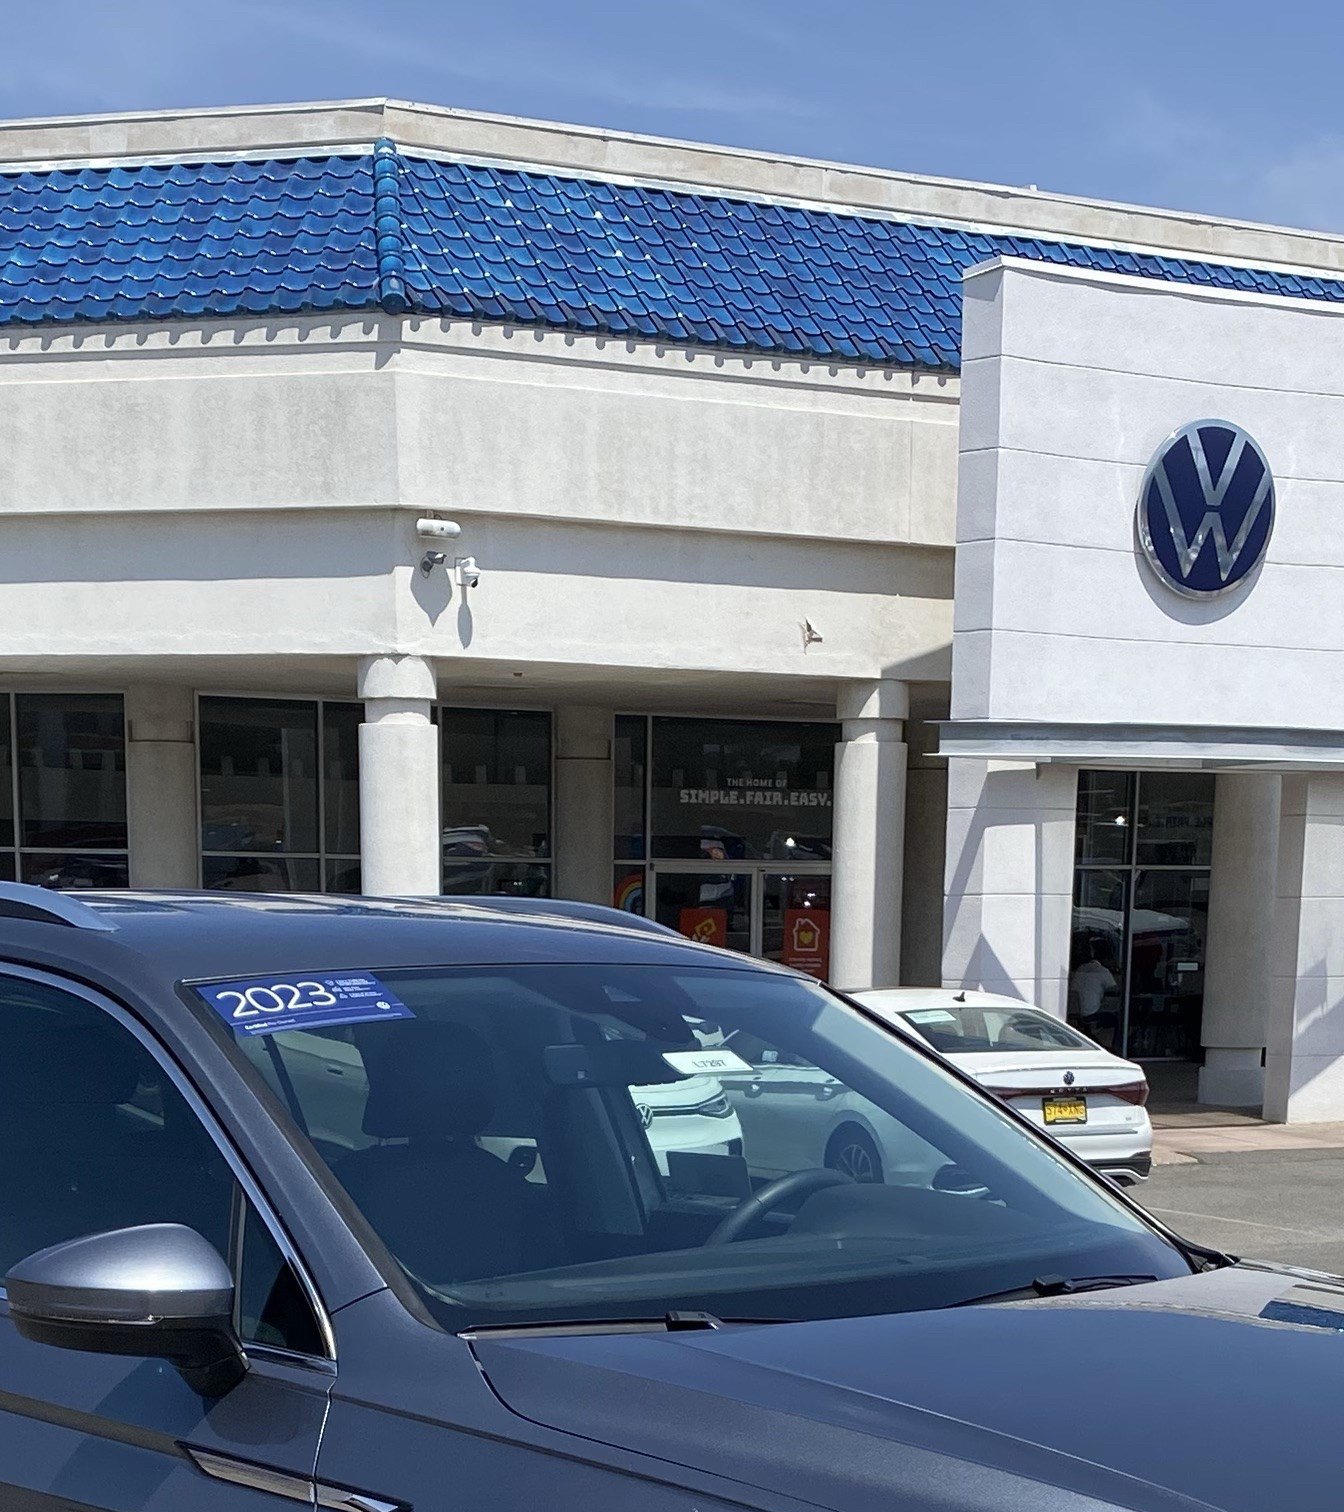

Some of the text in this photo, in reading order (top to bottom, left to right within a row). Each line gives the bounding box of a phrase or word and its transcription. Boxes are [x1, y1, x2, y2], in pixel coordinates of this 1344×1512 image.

[1140, 421, 1275, 598] VW
[726, 778, 787, 788] THE HOME OF
[680, 789, 832, 806] SIMPLE.FAIR.EASY.
[216, 981, 337, 1018] 2023
